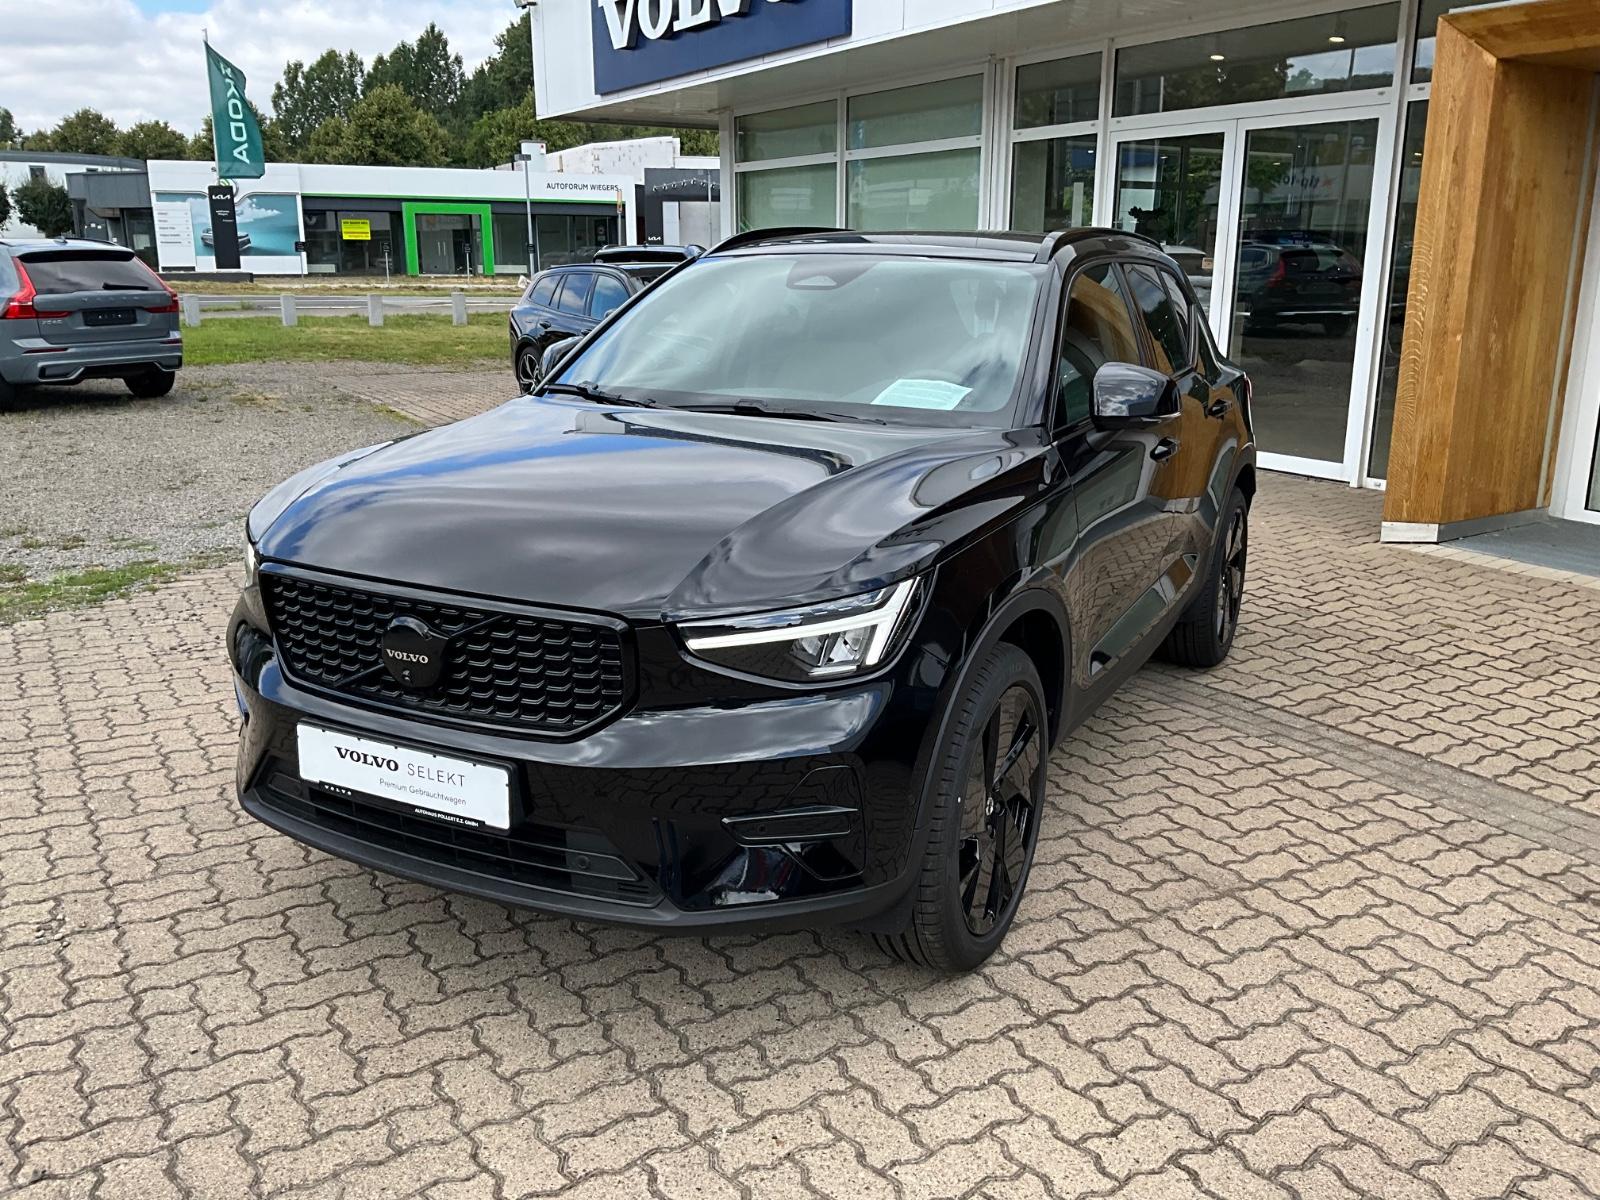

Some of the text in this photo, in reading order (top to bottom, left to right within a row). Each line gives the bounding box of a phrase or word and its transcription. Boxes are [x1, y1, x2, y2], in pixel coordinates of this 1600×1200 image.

[597, 0, 780, 50] VOL
[546, 182, 619, 192] AUTOFORUM WIEGERS
[385, 648, 429, 664] VOLVO
[334, 746, 465, 787] VOLVO SELEKT
[324, 784, 352, 796] VOLVO
[379, 777, 466, 806] Premium Gebrauchtwagen
